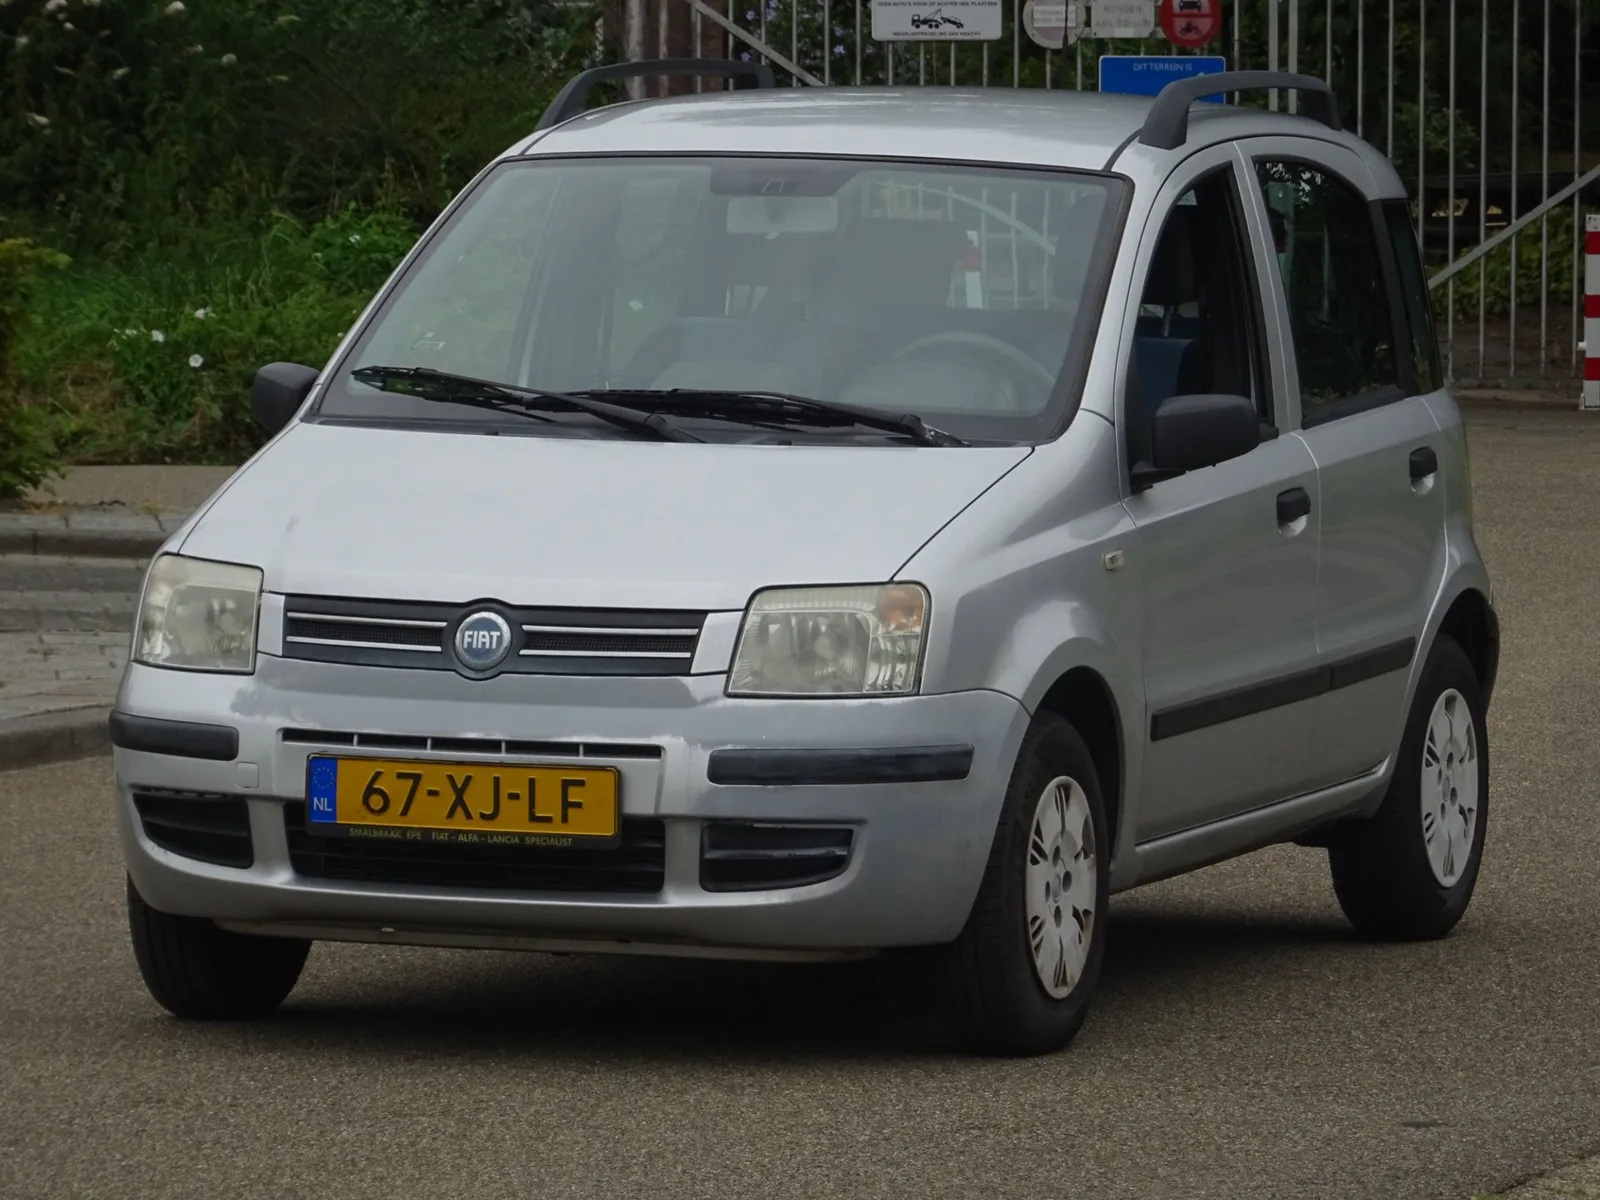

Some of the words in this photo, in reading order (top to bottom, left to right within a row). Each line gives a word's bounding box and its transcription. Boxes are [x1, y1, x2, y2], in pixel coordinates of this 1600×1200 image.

[1132, 63, 1148, 71] DIT
[1149, 63, 1184, 71] TERREIN
[1185, 63, 1193, 71] IS
[463, 630, 501, 649] FIAT
[313, 797, 332, 811] NL
[361, 769, 587, 824] 67-XJ-LF
[349, 827, 402, 839] SMALBRAAK
[406, 830, 422, 840] EPE
[432, 831, 451, 841] FIAT
[458, 833, 479, 843] ALFA
[487, 834, 520, 845] LANCIA
[525, 836, 573, 847] SPECIALIST
